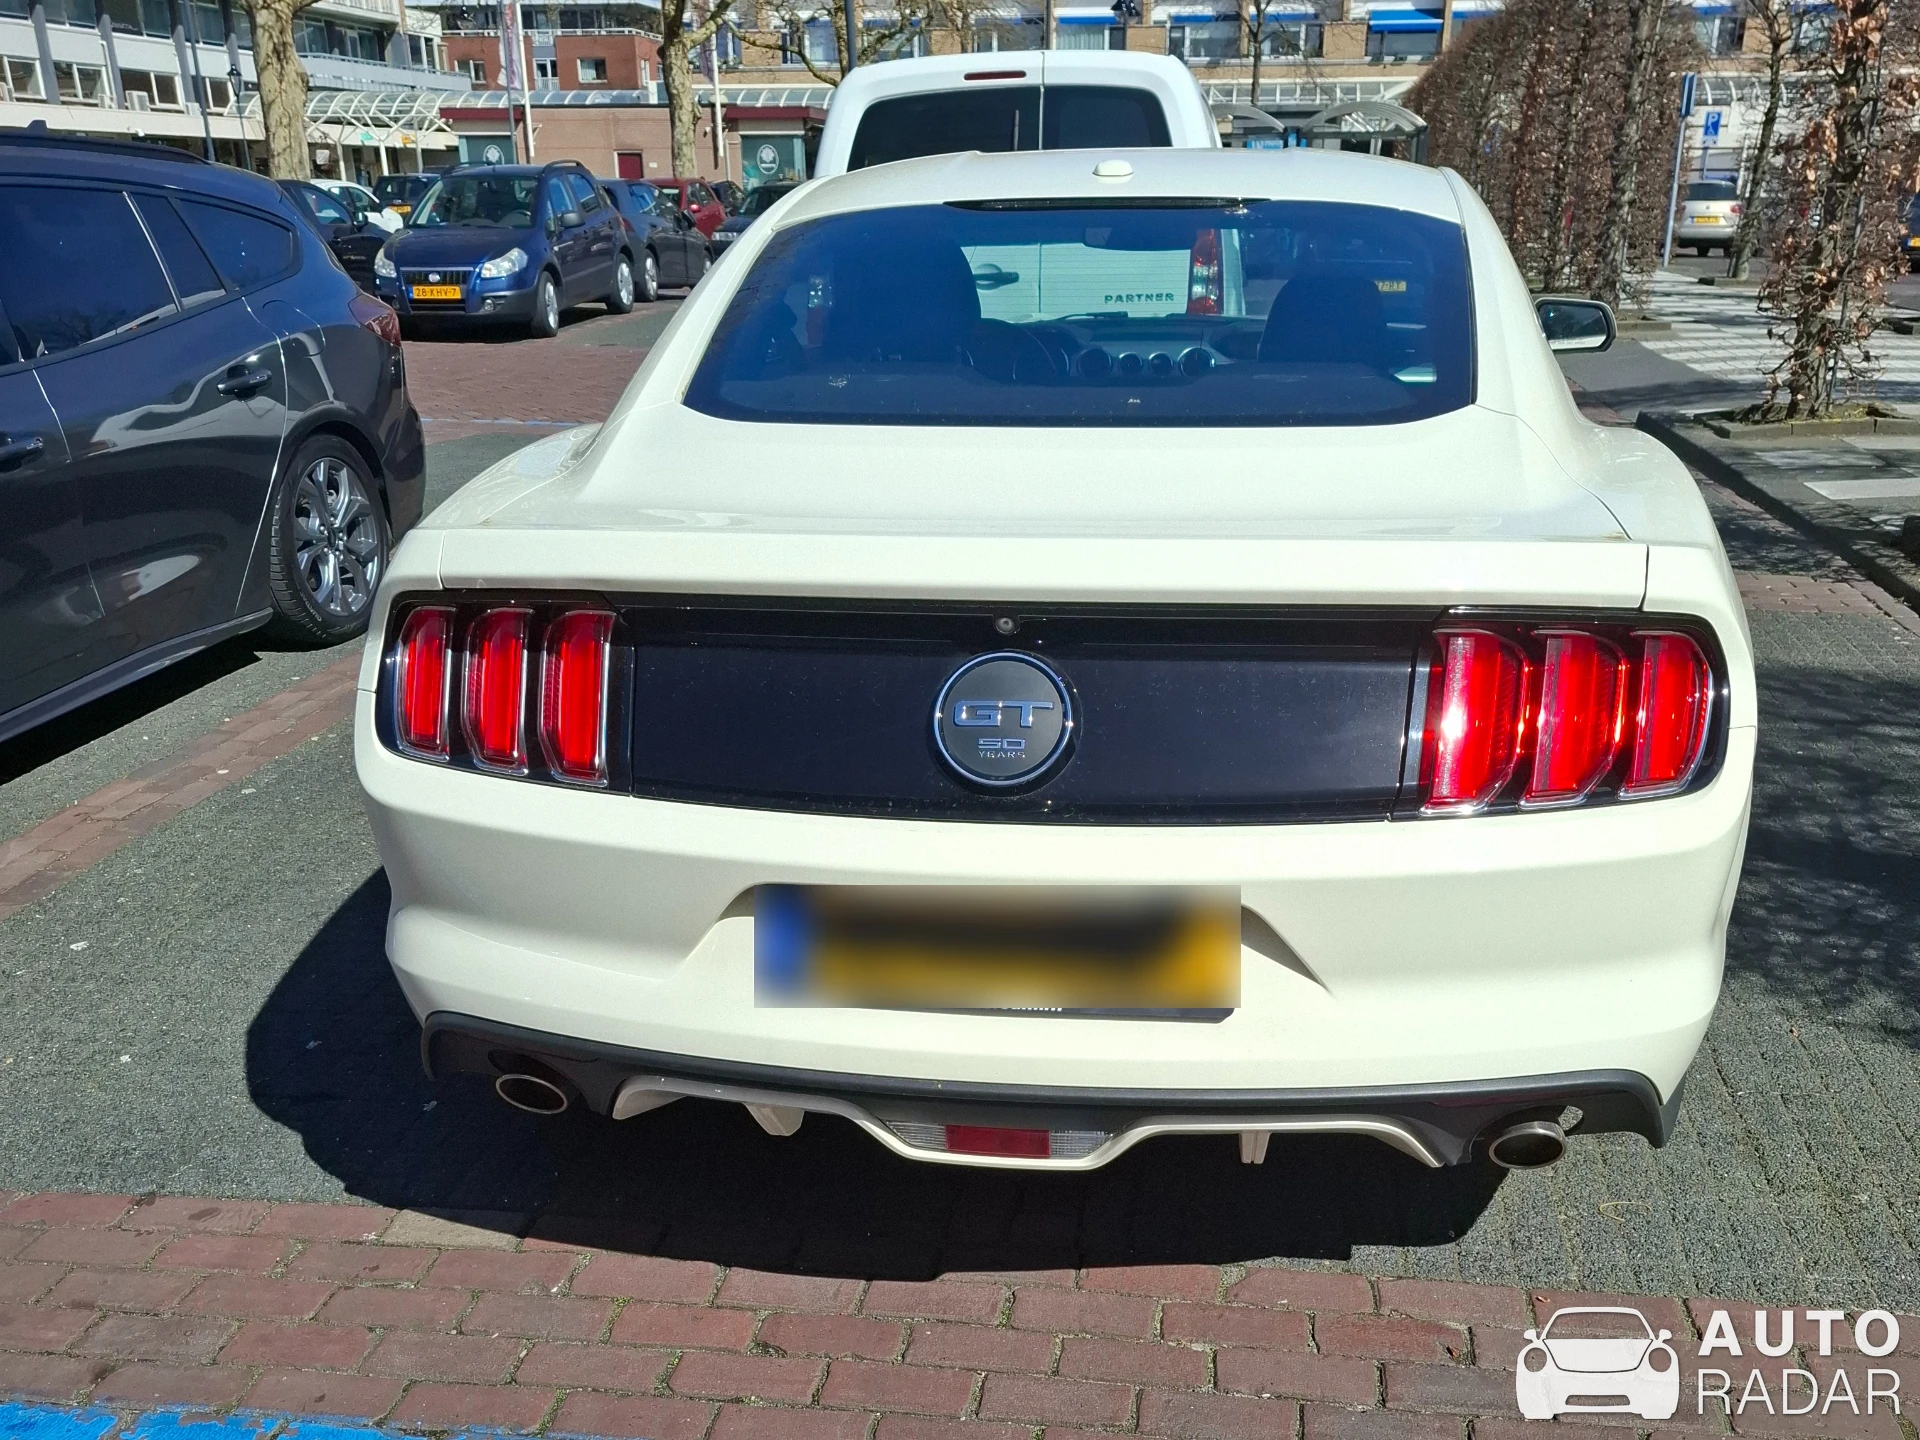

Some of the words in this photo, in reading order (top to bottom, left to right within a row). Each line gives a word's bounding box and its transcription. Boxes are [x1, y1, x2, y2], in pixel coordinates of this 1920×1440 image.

[1707, 112, 1719, 126] P
[415, 287, 457, 297] 28-KHV-7
[1104, 292, 1174, 303] PARTNER
[954, 700, 1054, 728] GT
[978, 738, 1026, 749] 50
[978, 751, 1026, 759] YEARS
